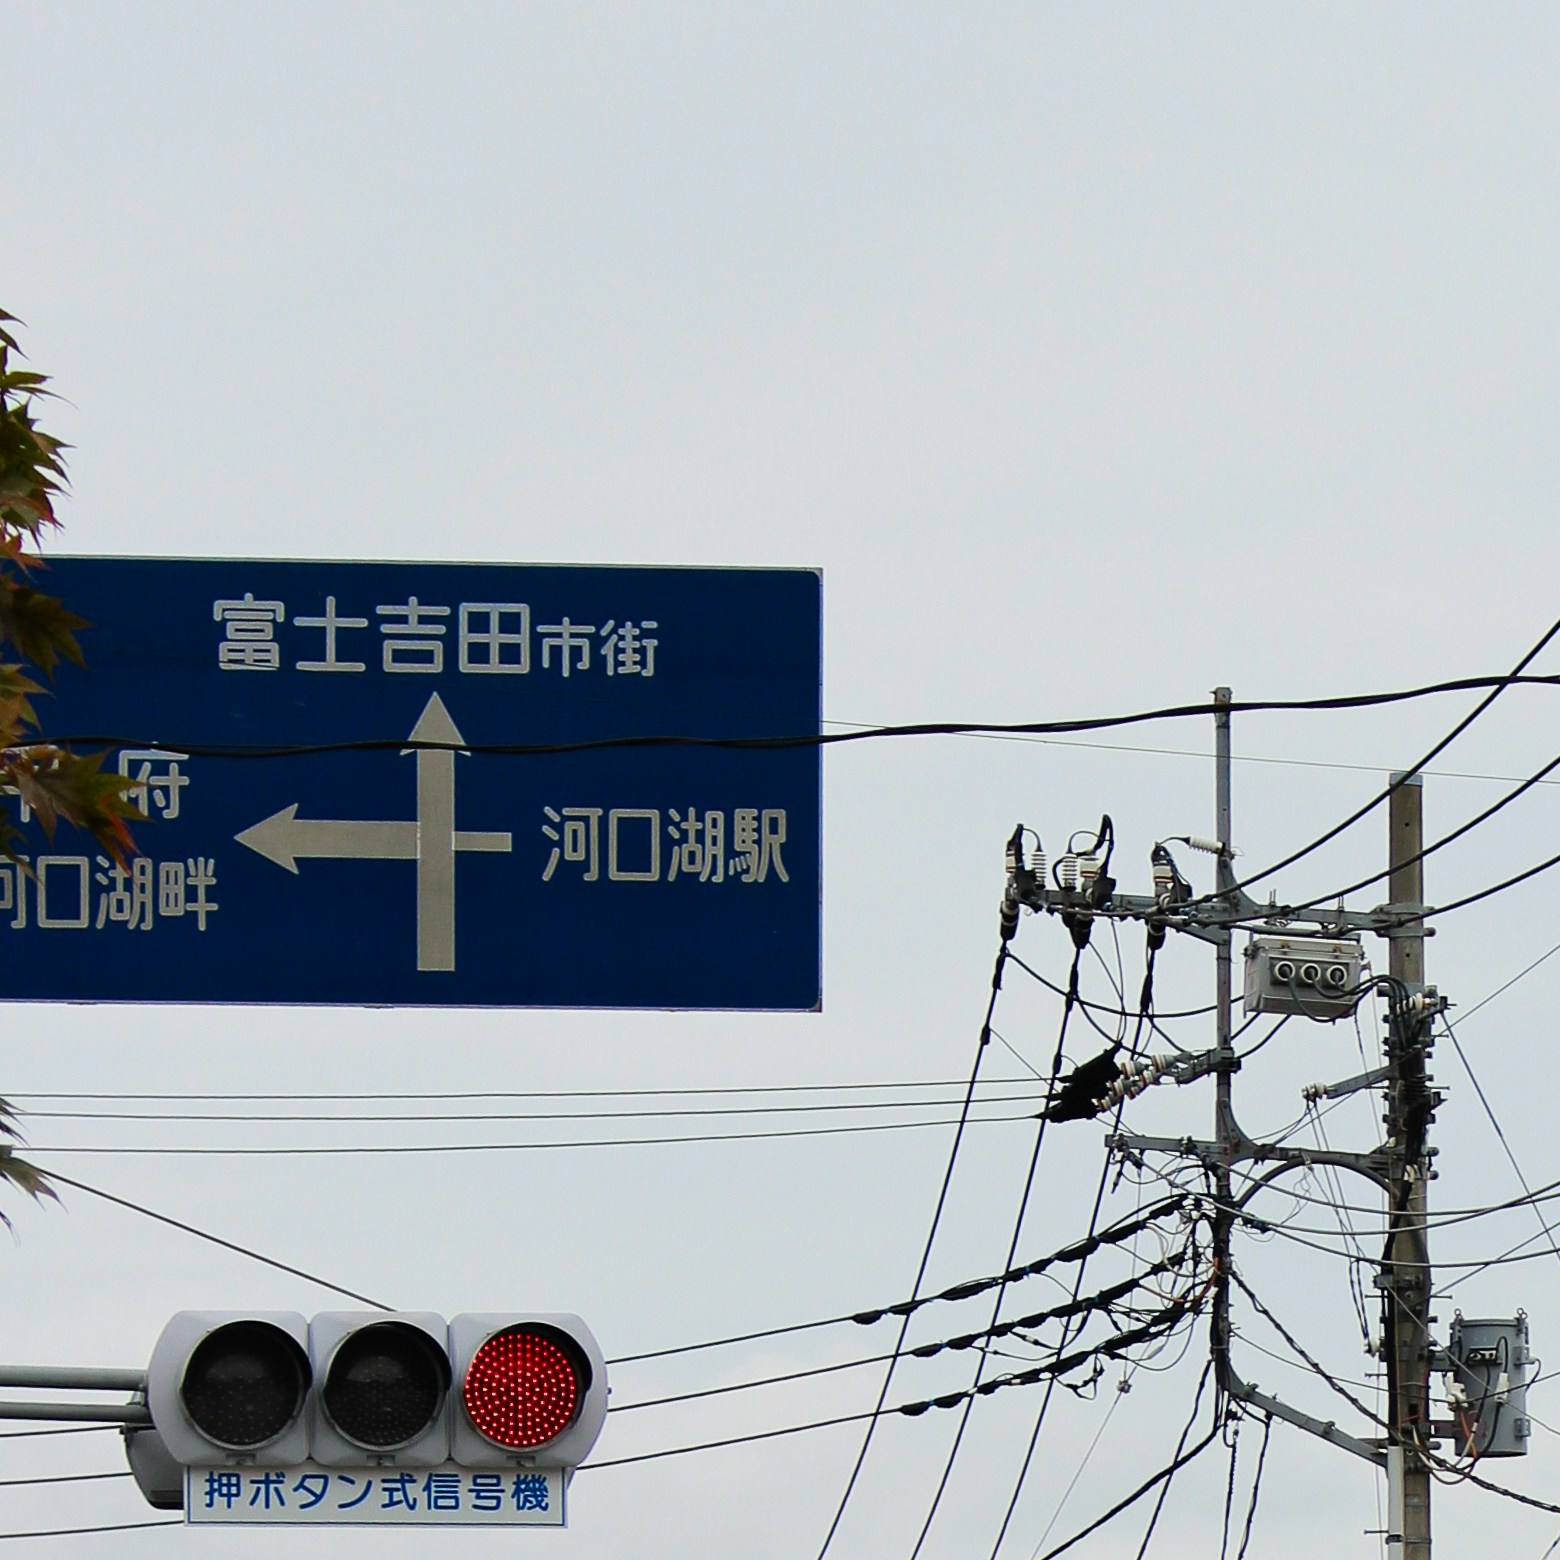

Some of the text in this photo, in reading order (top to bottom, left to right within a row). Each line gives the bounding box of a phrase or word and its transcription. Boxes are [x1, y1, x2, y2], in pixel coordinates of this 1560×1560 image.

[213, 593, 658, 678] 富士吉田市街
[541, 806, 790, 883] 河口湖駅
[205, 1471, 550, 1511] 押ボタン式信号機
